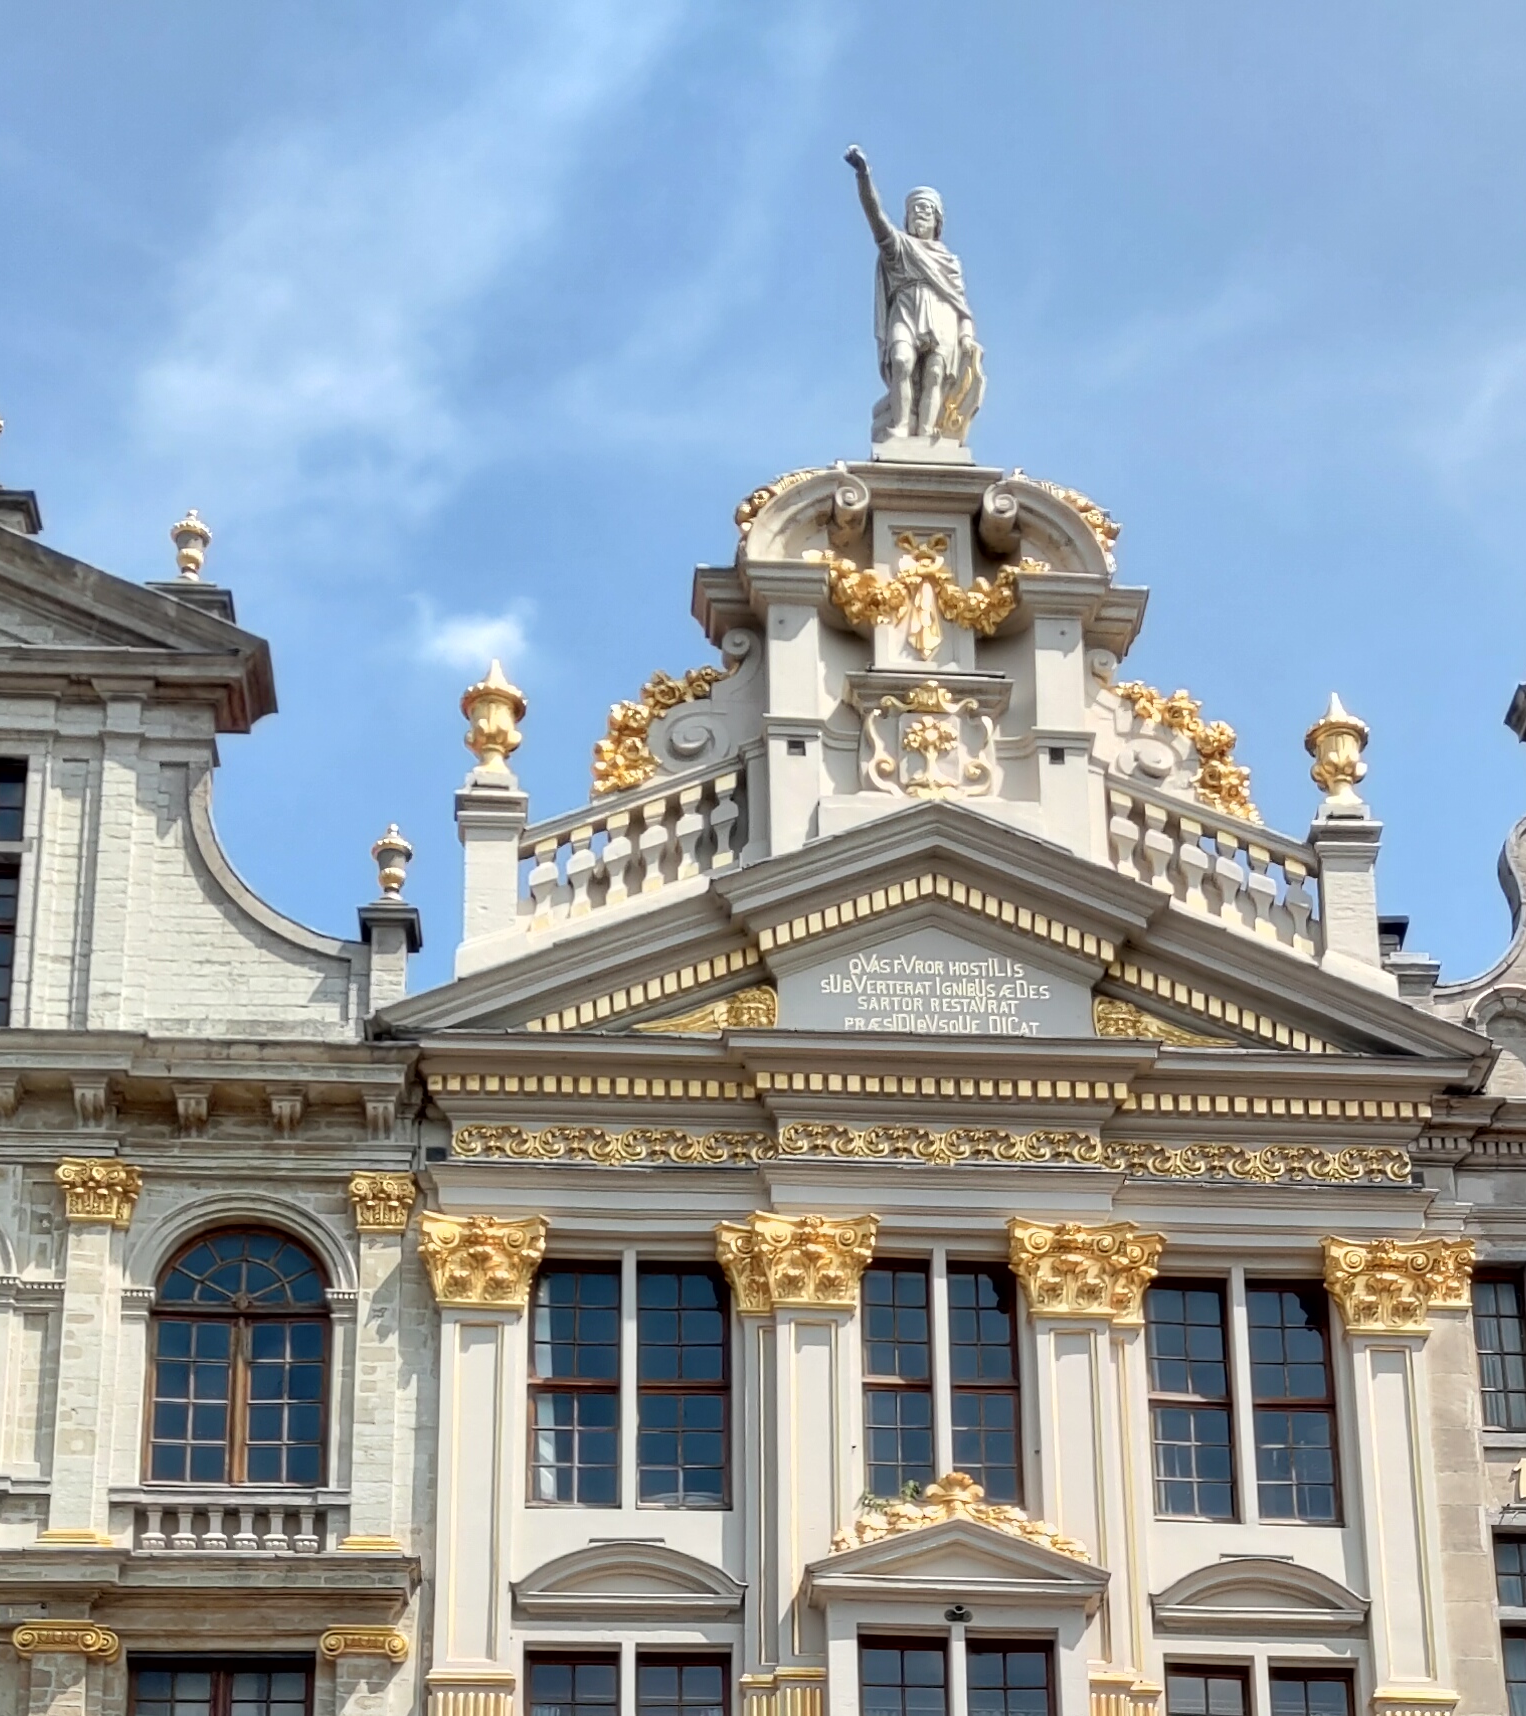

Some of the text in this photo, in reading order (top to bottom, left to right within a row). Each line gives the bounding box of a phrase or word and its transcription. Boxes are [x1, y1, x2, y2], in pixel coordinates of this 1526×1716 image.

[949, 957, 1024, 978] HOSTILIS
[857, 996, 923, 1012] SARTOR
[989, 1015, 1041, 1036] DICAT
